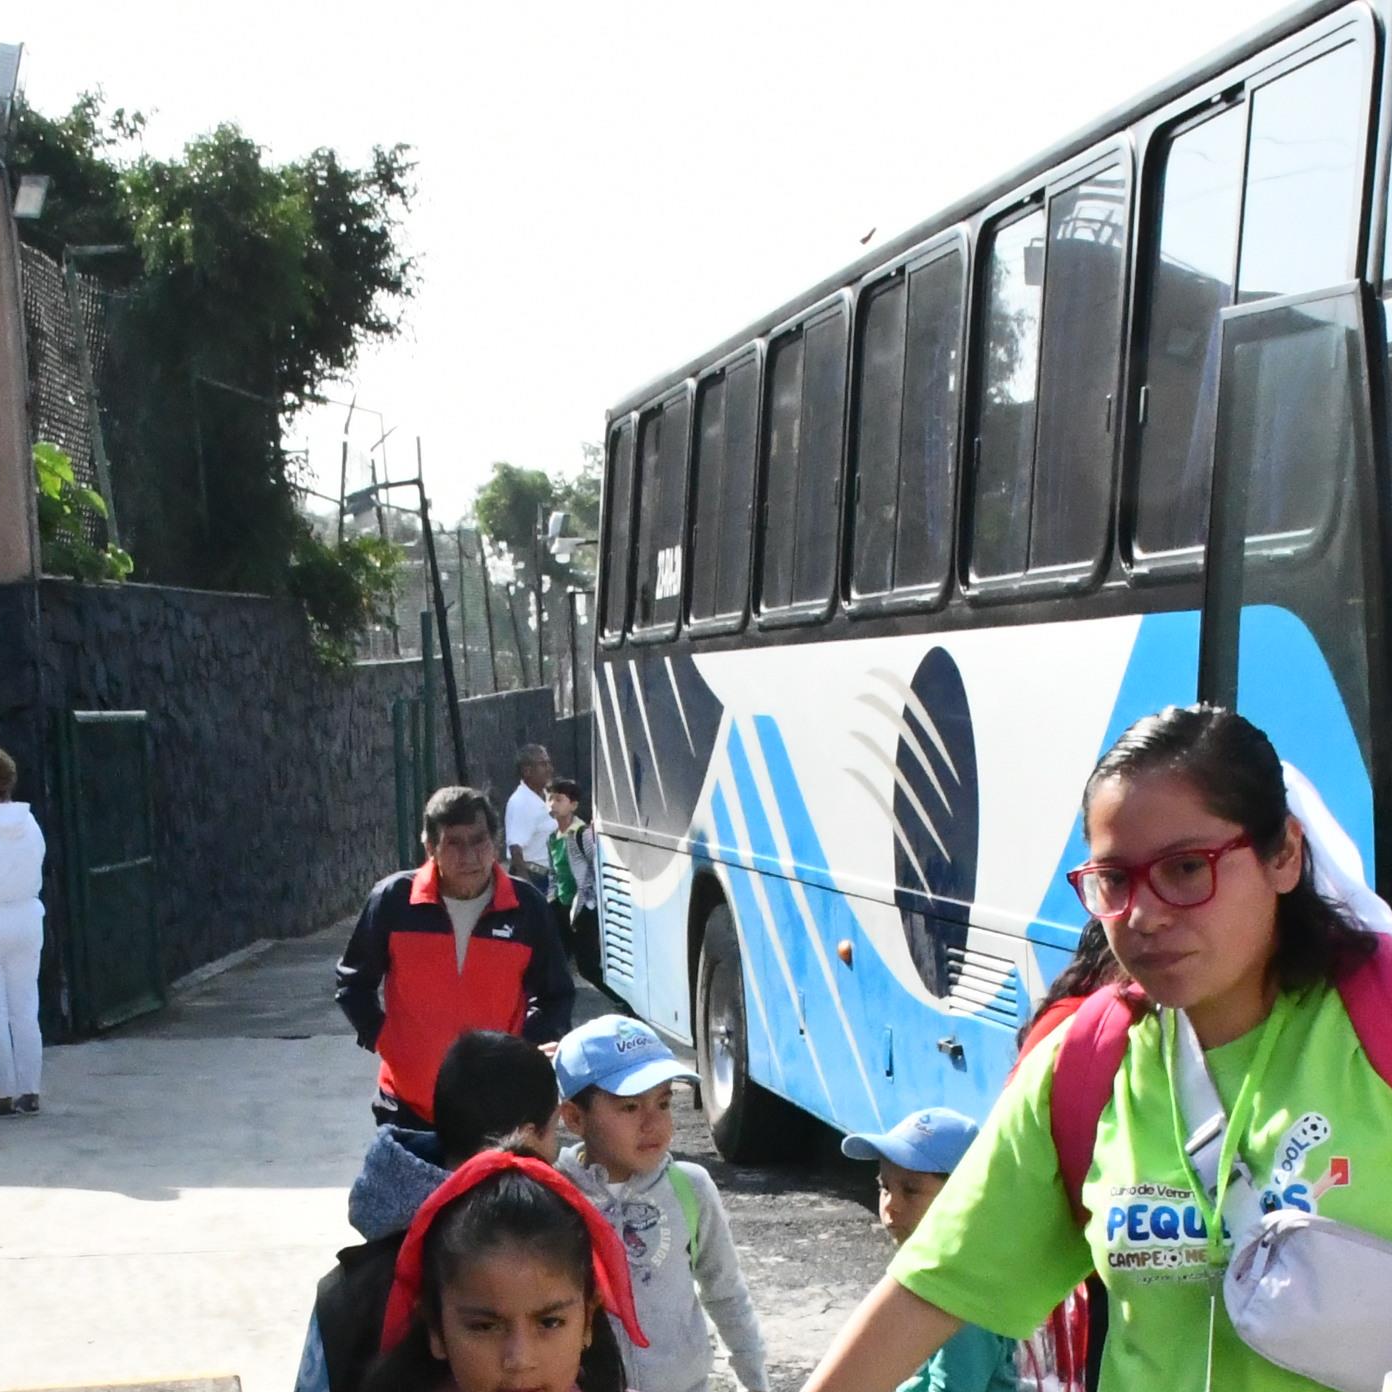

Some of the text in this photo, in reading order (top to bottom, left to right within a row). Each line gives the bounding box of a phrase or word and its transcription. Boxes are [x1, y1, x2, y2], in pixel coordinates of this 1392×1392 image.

[1138, 1184, 1155, 1195] de
[1157, 1185, 1197, 1198] Veran
[1108, 1247, 1208, 1267] CAMPEONE
